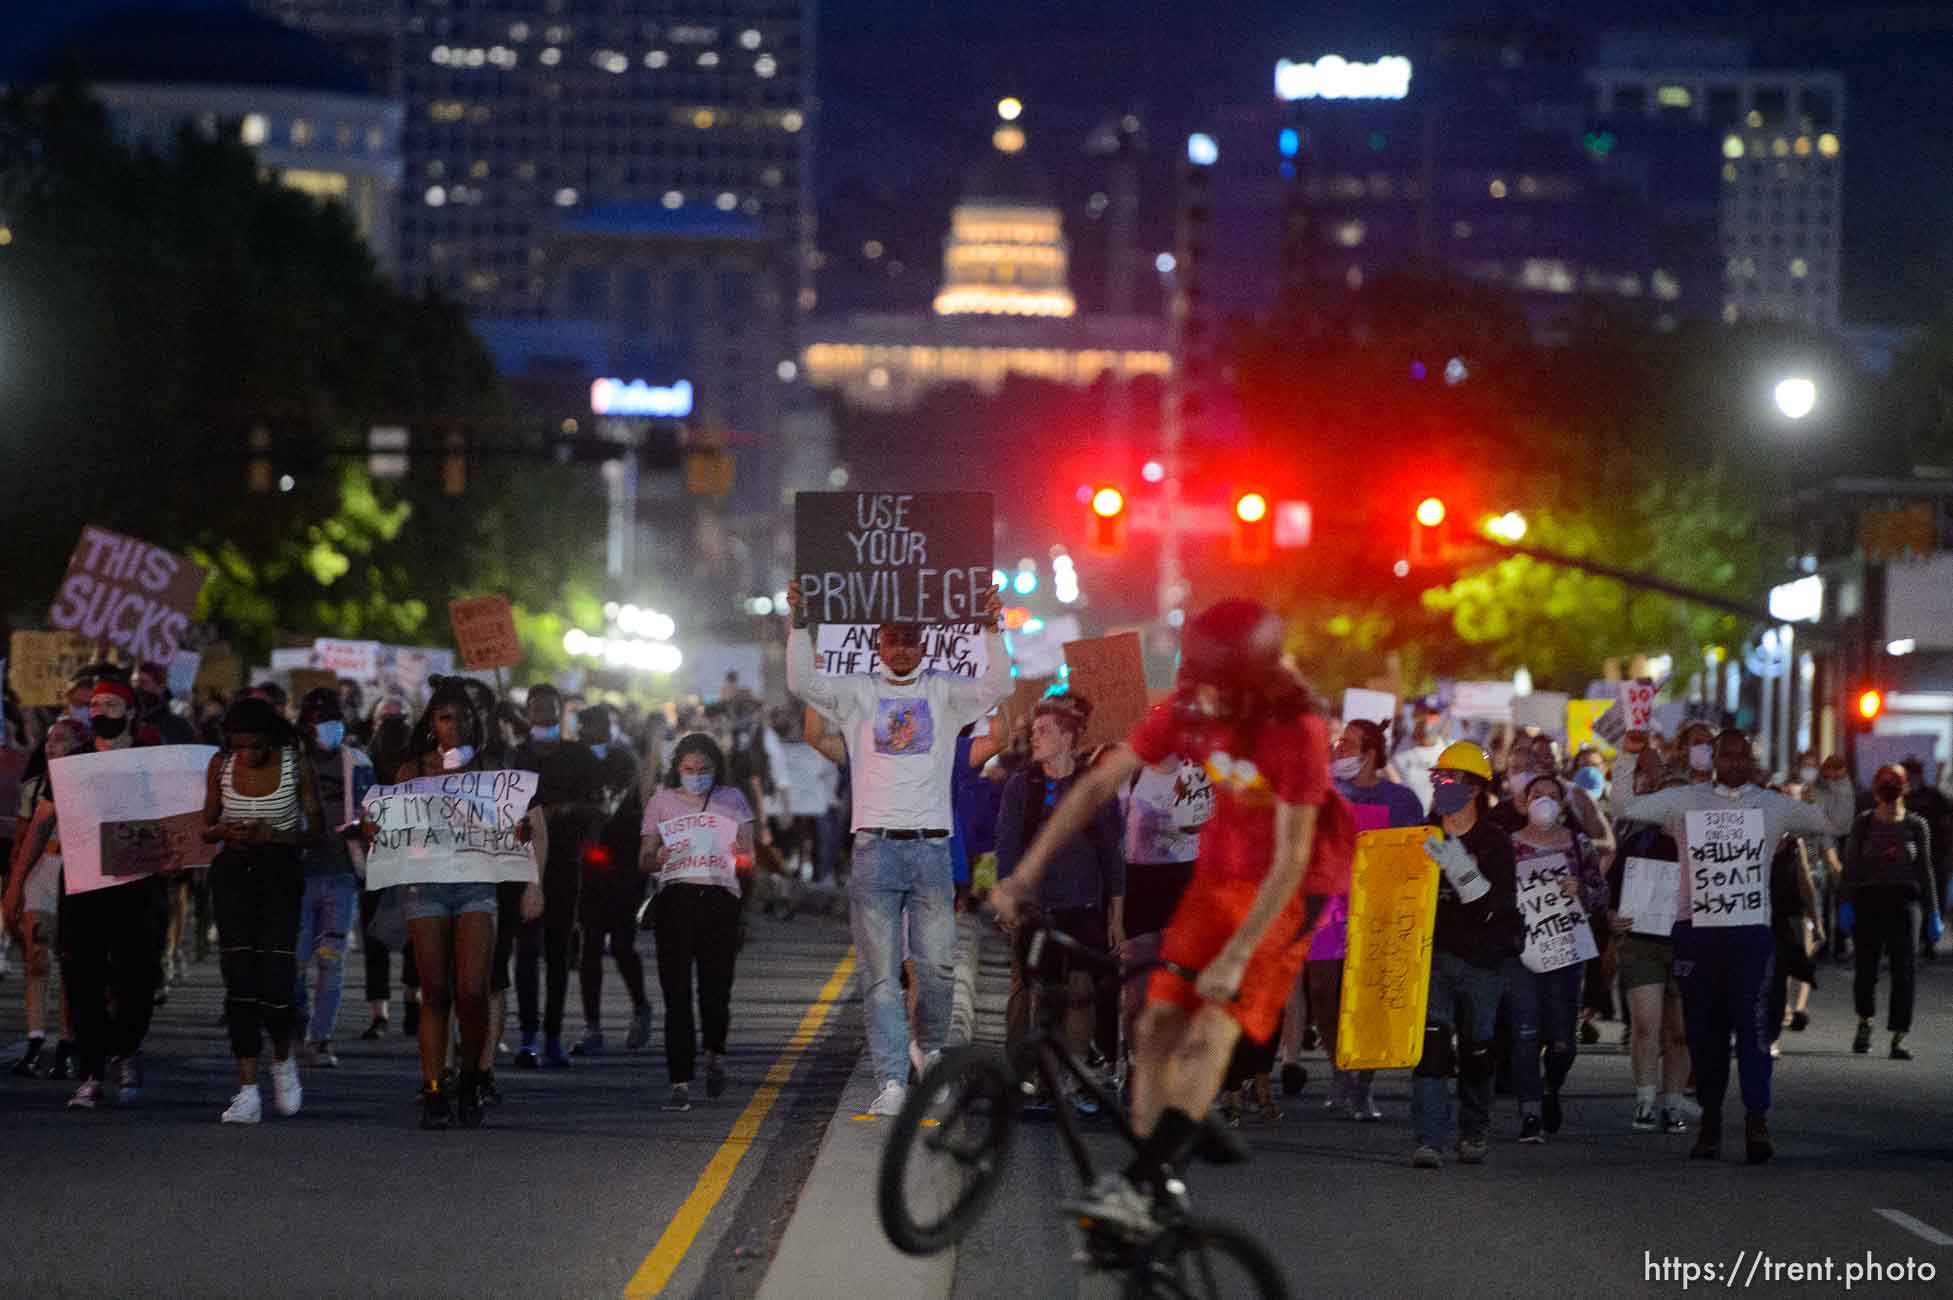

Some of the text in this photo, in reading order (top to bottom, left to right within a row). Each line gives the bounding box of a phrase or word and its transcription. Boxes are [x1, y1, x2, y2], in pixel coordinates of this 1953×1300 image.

[857, 494, 913, 532] USE
[82, 527, 178, 592] THIS
[848, 530, 928, 565] YOUR
[800, 566, 988, 623] PRIVILEGE
[52, 574, 188, 665] SUCKS
[823, 650, 863, 674] THE
[442, 771, 525, 802] COLOR
[368, 796, 514, 833] OF MY SKIN IS
[423, 827, 440, 848] A
[1690, 839, 1765, 862] MATTER
[1693, 891, 1762, 914] BLACK
